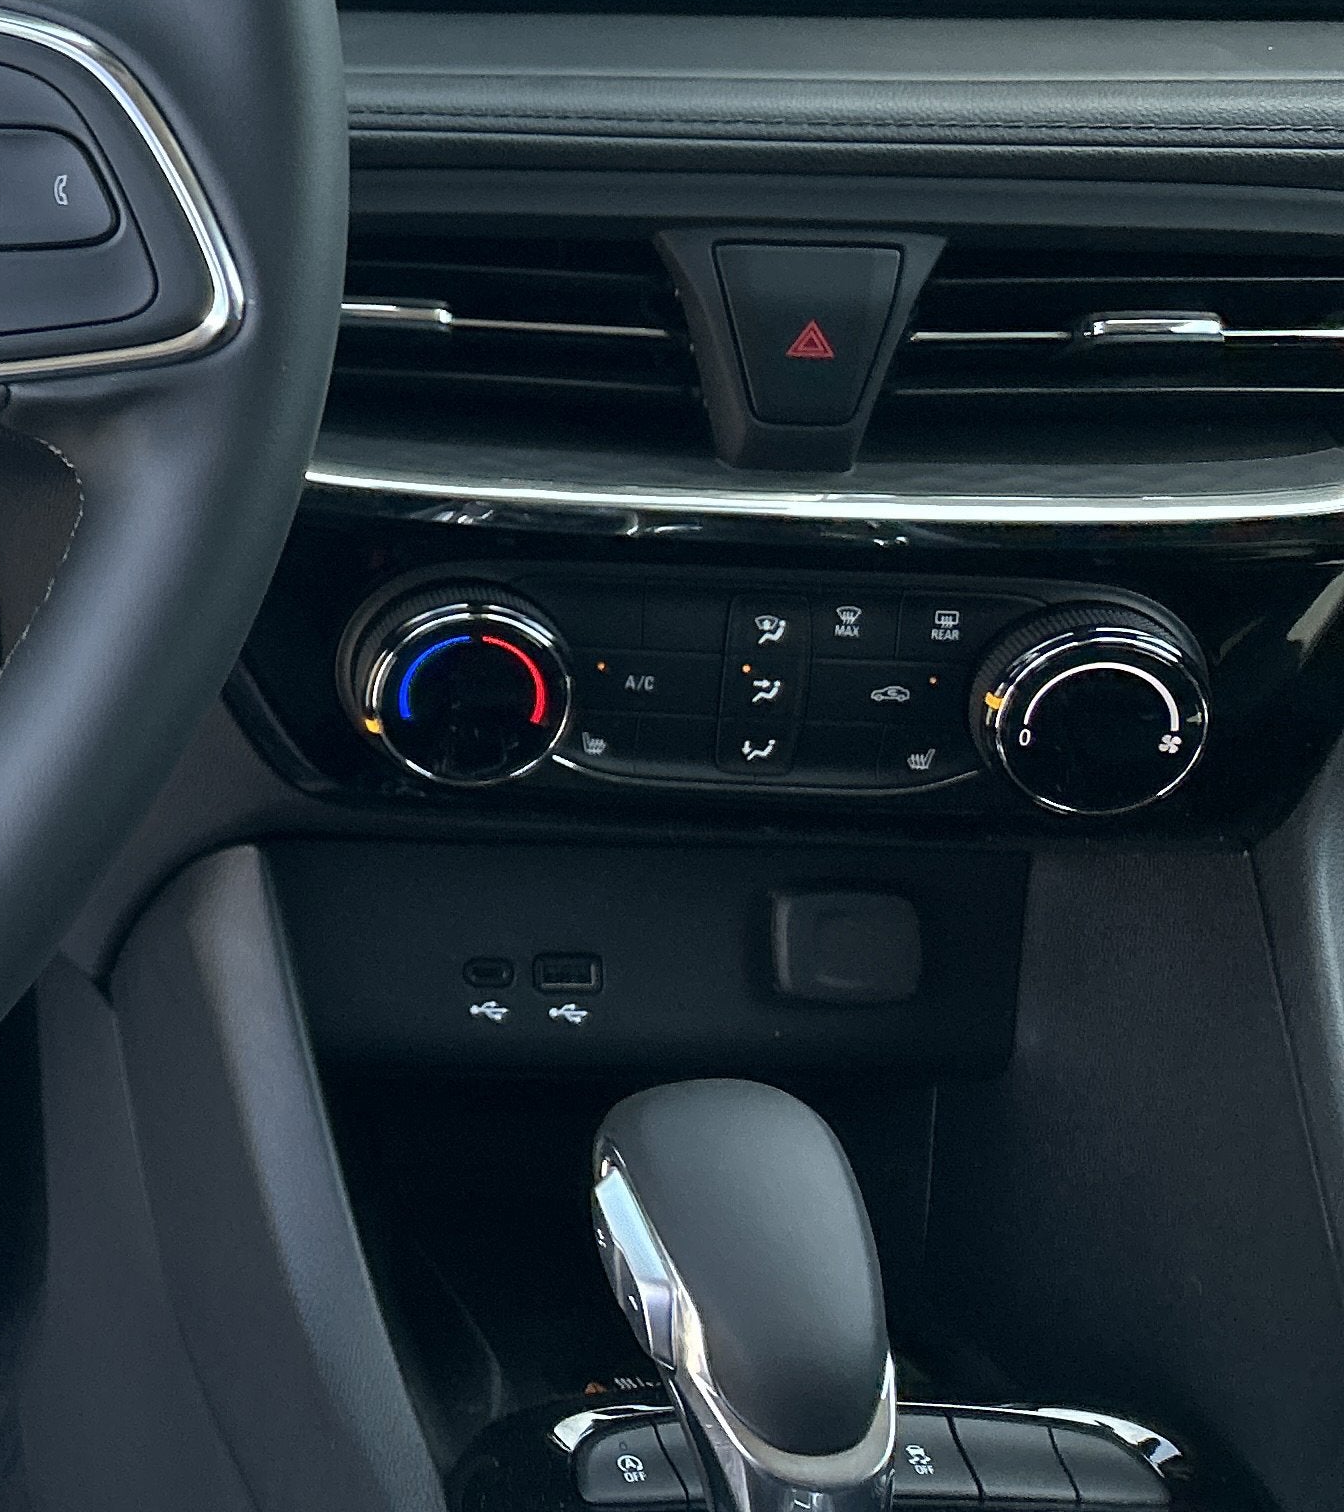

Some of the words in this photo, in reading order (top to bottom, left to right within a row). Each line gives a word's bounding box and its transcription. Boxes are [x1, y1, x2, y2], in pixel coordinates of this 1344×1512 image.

[834, 625, 860, 638] MAX
[930, 628, 960, 641] REAR
[625, 674, 655, 691] A/C
[1018, 728, 1031, 746] 0
[914, 1464, 934, 1475] OFF
[623, 1471, 646, 1483] OFF
